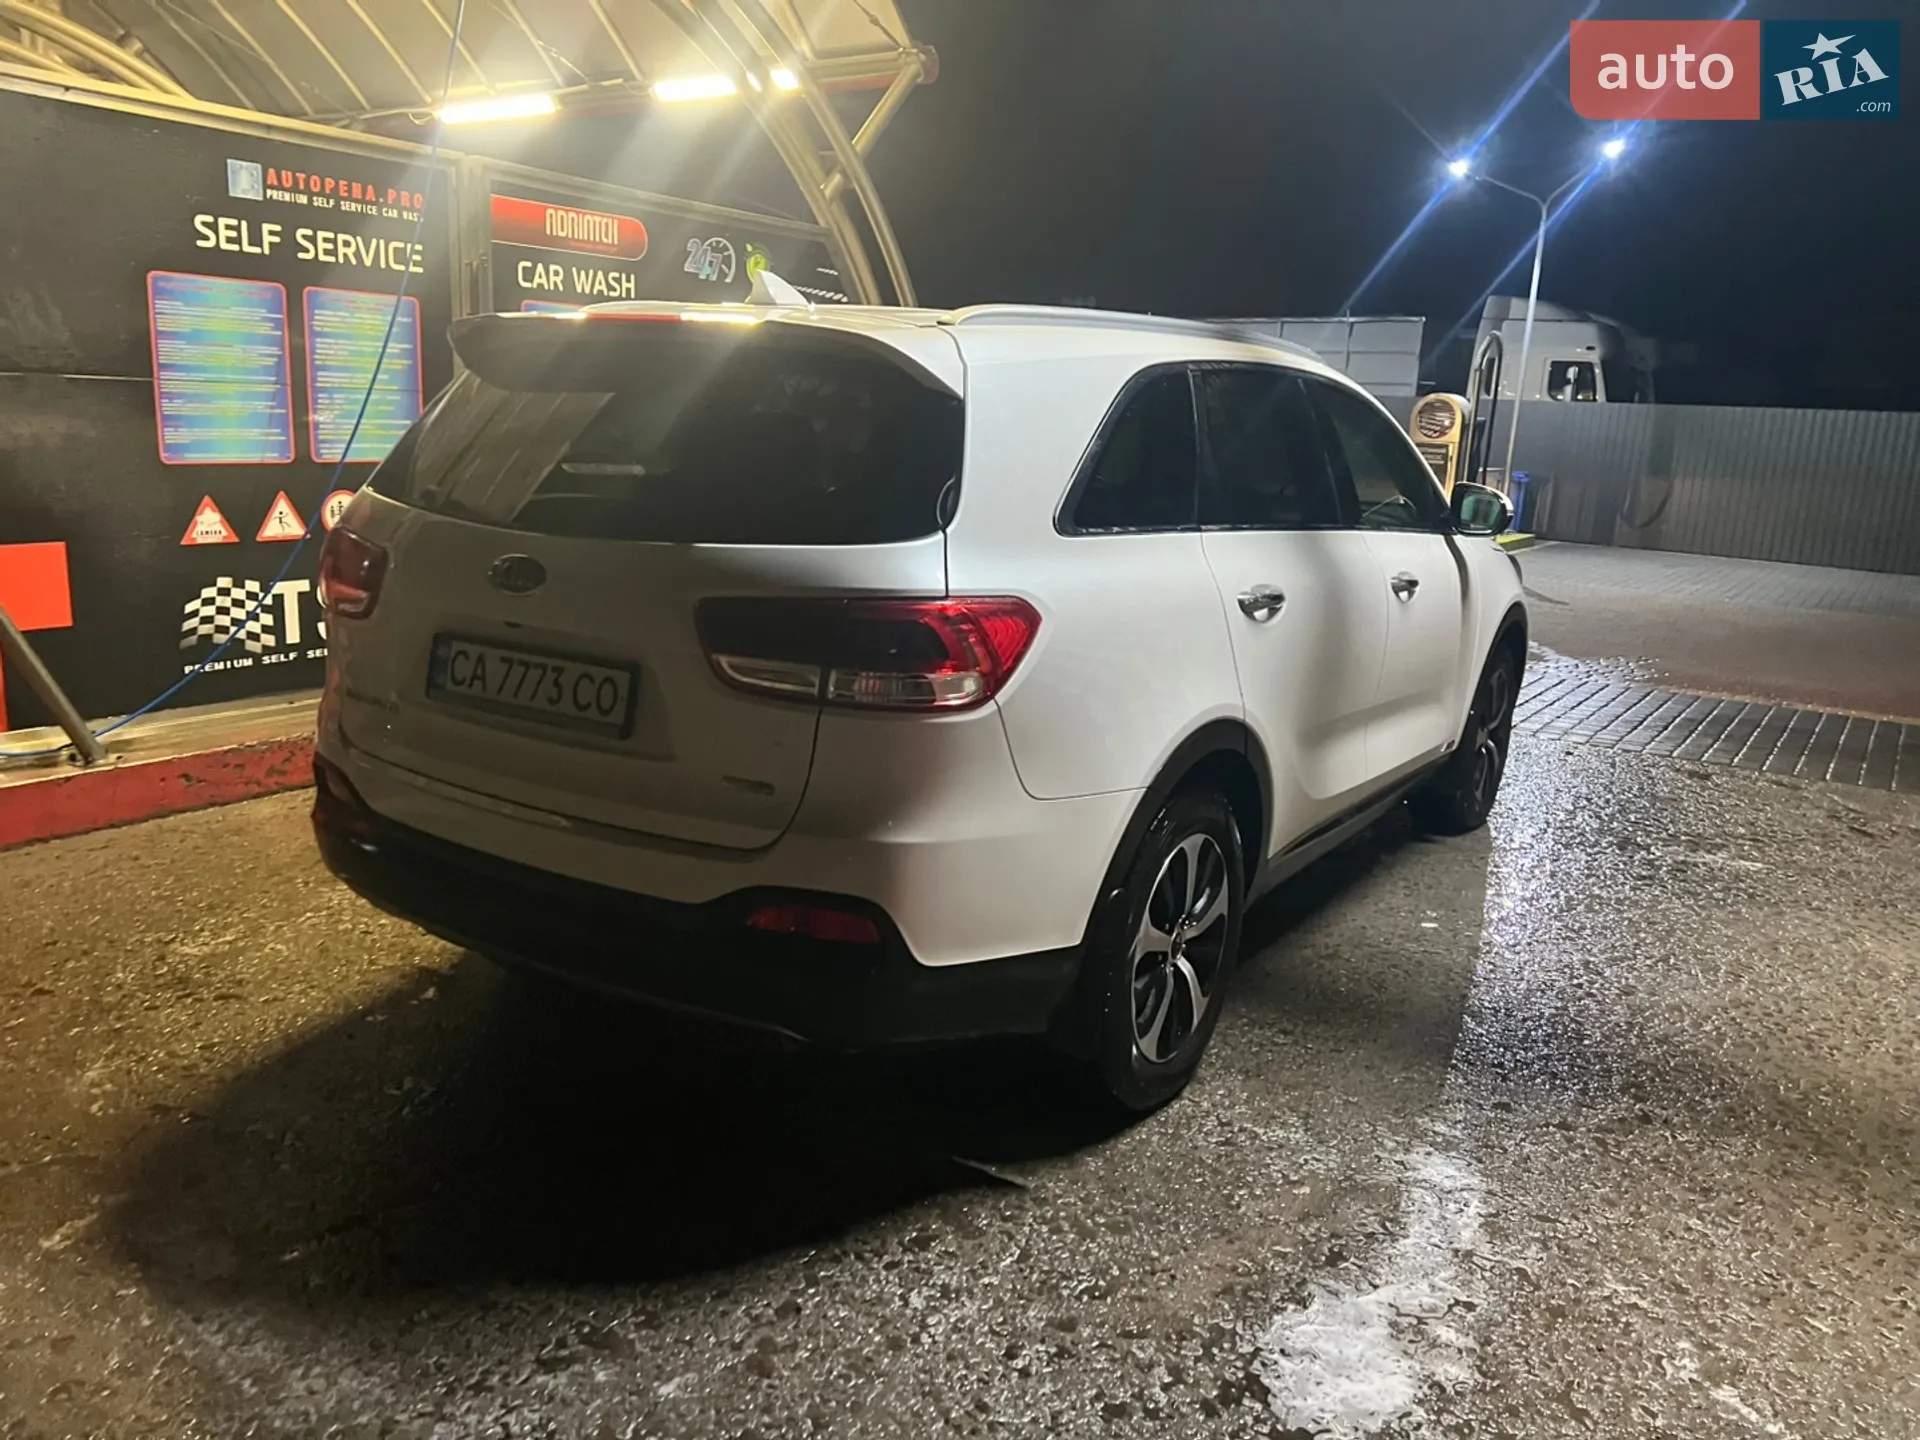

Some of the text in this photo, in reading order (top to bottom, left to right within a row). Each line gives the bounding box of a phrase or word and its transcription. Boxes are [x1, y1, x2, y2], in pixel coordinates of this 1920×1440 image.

[266, 188, 308, 205] PREMIUM
[312, 196, 335, 208] SELF
[340, 200, 378, 216] SERVICE
[382, 207, 399, 219] CAR
[193, 213, 424, 274] SELF SERVICE
[517, 260, 636, 299] CAR WASH
[183, 657, 253, 675] PREMIUM
[261, 651, 298, 665] SELF
[450, 649, 619, 717] CA 7773 CO
